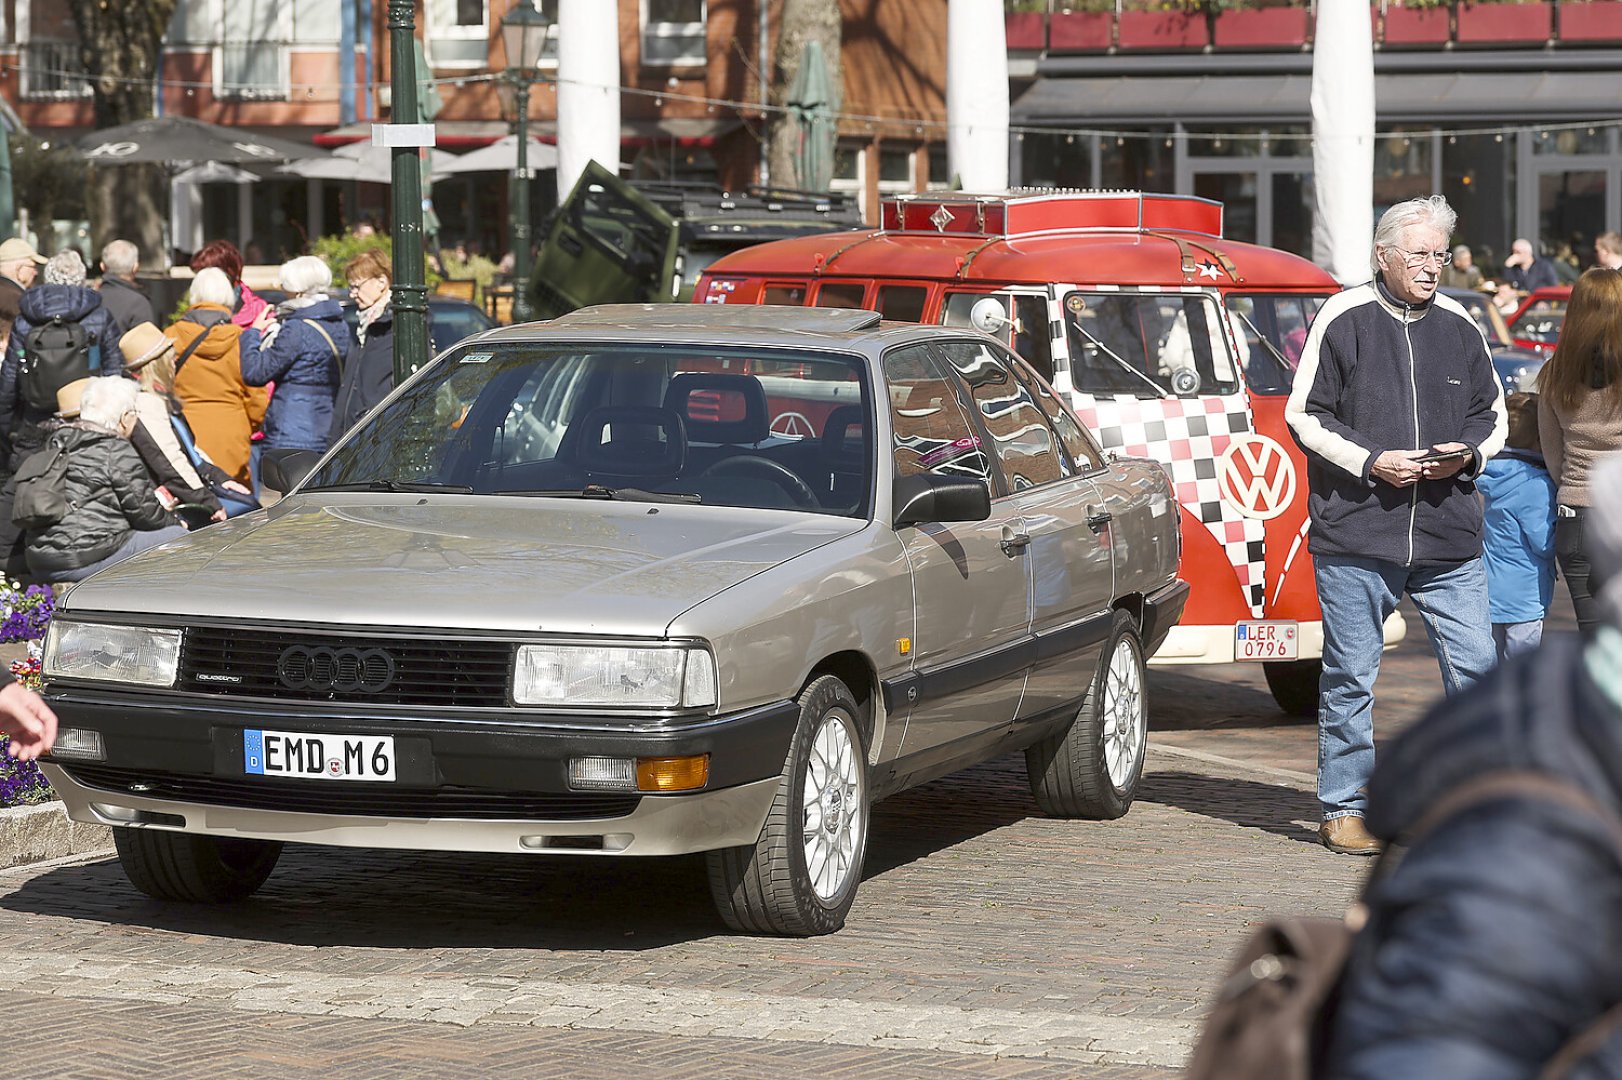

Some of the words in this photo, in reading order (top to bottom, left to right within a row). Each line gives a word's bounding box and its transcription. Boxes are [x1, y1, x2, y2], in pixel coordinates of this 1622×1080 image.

[1220, 435, 1295, 519] VW
[1248, 626, 1275, 640] LER
[1245, 642, 1286, 657] 0796
[250, 757, 258, 767] D
[265, 735, 325, 774] EMD
[344, 740, 364, 775] M
[372, 741, 389, 775] 6
